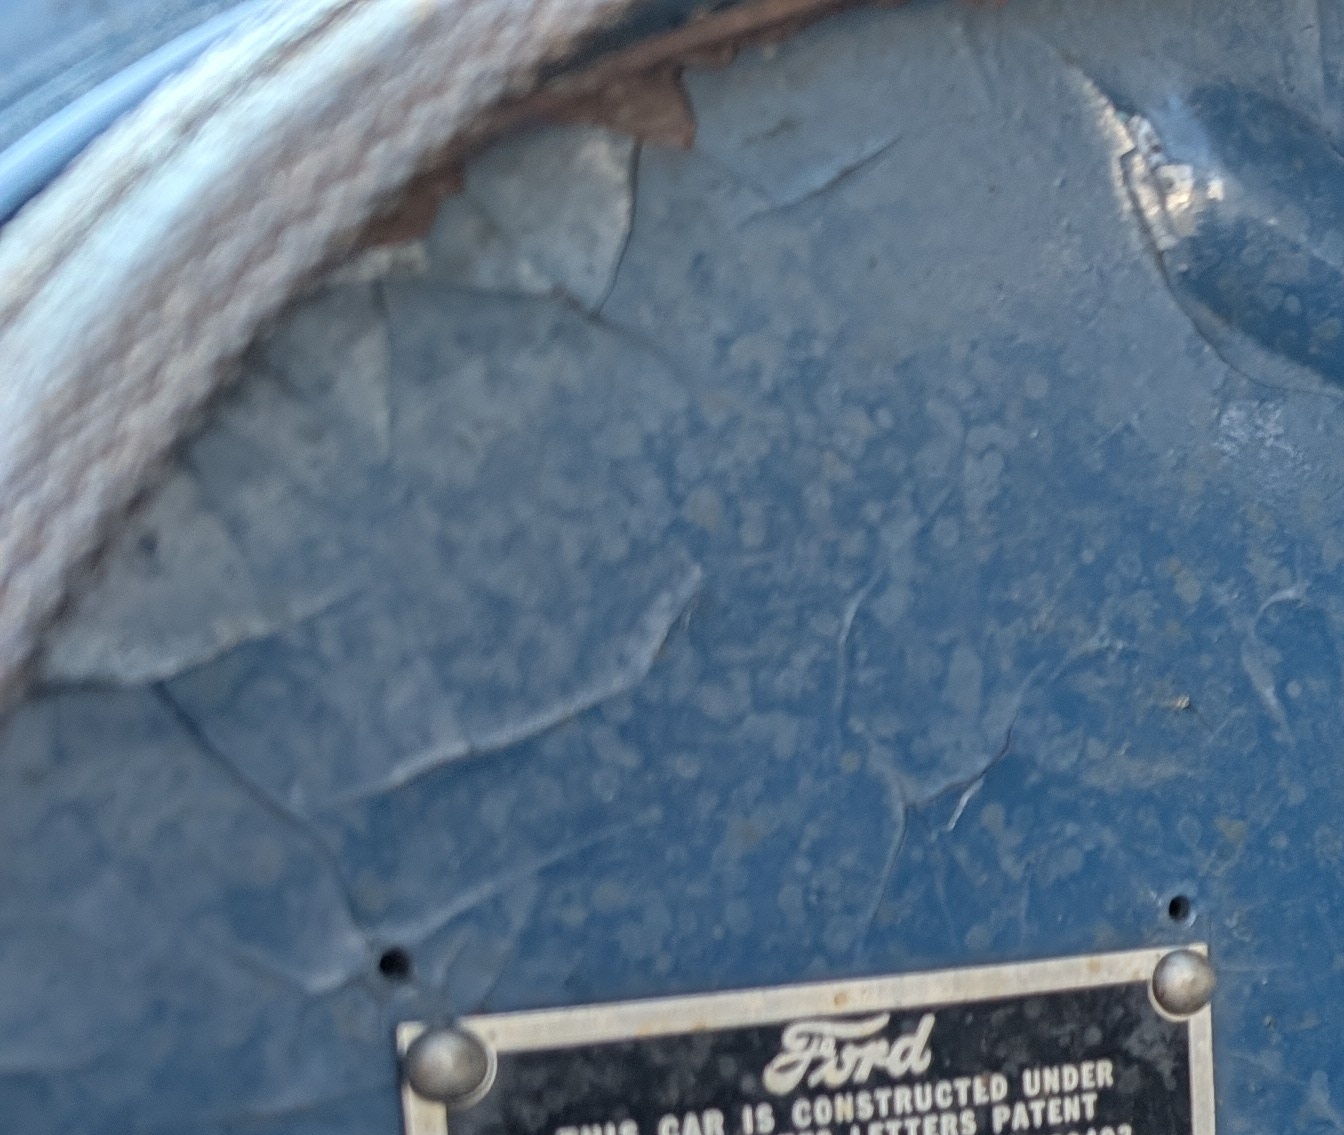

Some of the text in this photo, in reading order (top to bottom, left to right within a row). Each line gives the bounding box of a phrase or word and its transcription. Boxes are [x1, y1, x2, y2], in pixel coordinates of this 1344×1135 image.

[764, 1013, 935, 1093] Ford
[744, 1103, 774, 1134] IS
[793, 1074, 1007, 1126] CONSTRUCTED
[1024, 1060, 1113, 1096] UNDER
[993, 1093, 1097, 1133] PATENT
